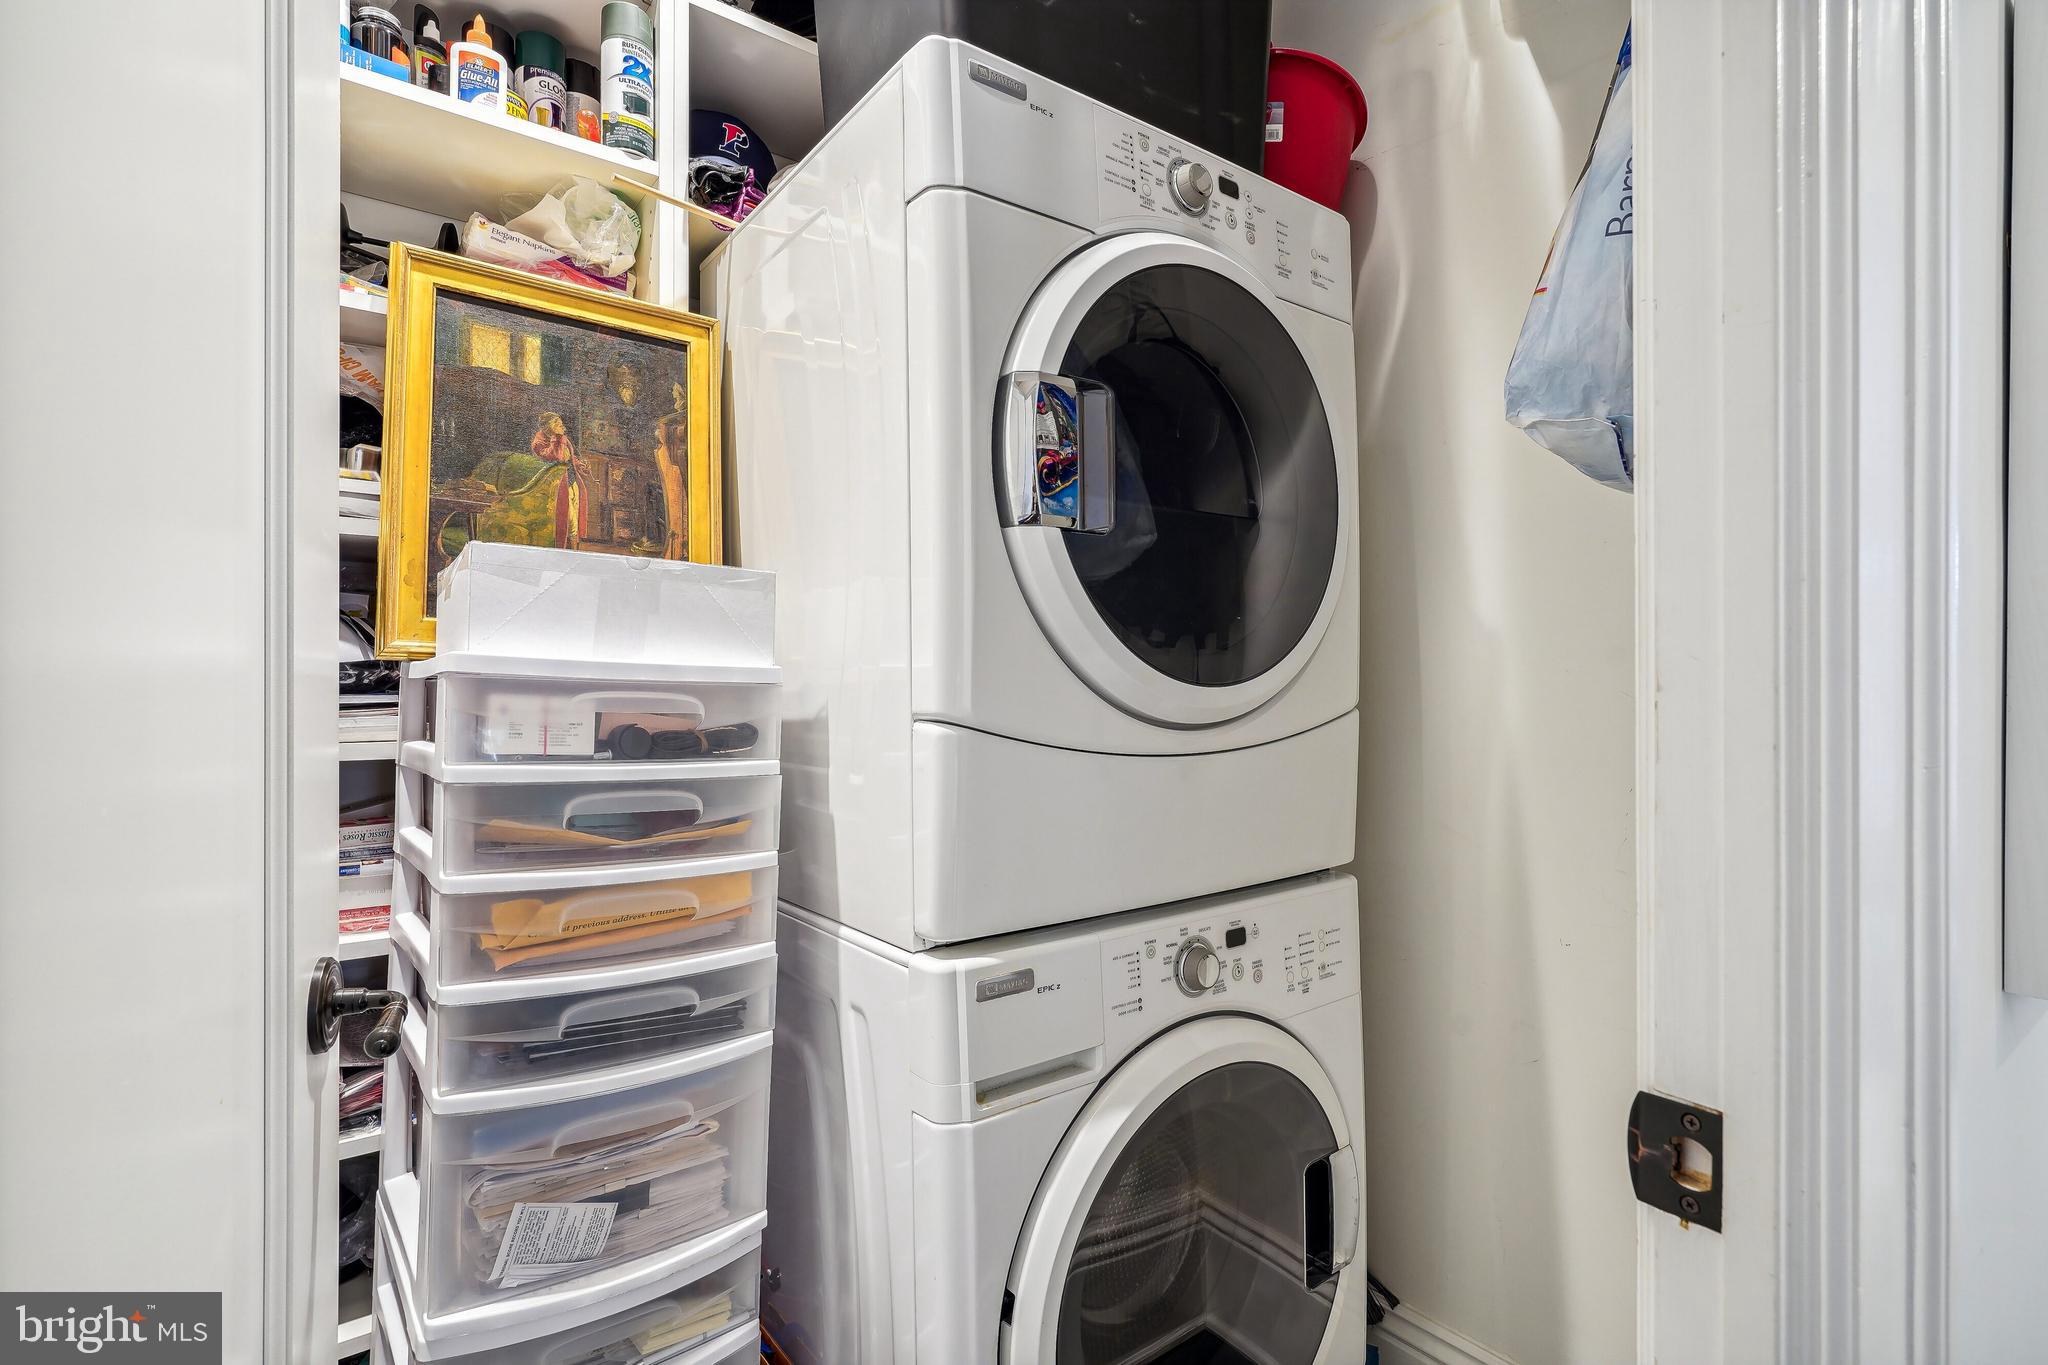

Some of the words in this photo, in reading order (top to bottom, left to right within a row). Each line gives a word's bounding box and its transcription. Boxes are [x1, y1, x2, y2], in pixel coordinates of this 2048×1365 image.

[461, 70, 498, 88] Glue-All
[1029, 103, 1047, 116] EPIC
[719, 122, 750, 158] P
[1604, 144, 1632, 237] Bar
[490, 227, 522, 246] Elegant
[522, 238, 556, 255] Napkins
[342, 832, 366, 842] Roses
[572, 918, 610, 932] previous
[1037, 983, 1055, 994] EPIC
